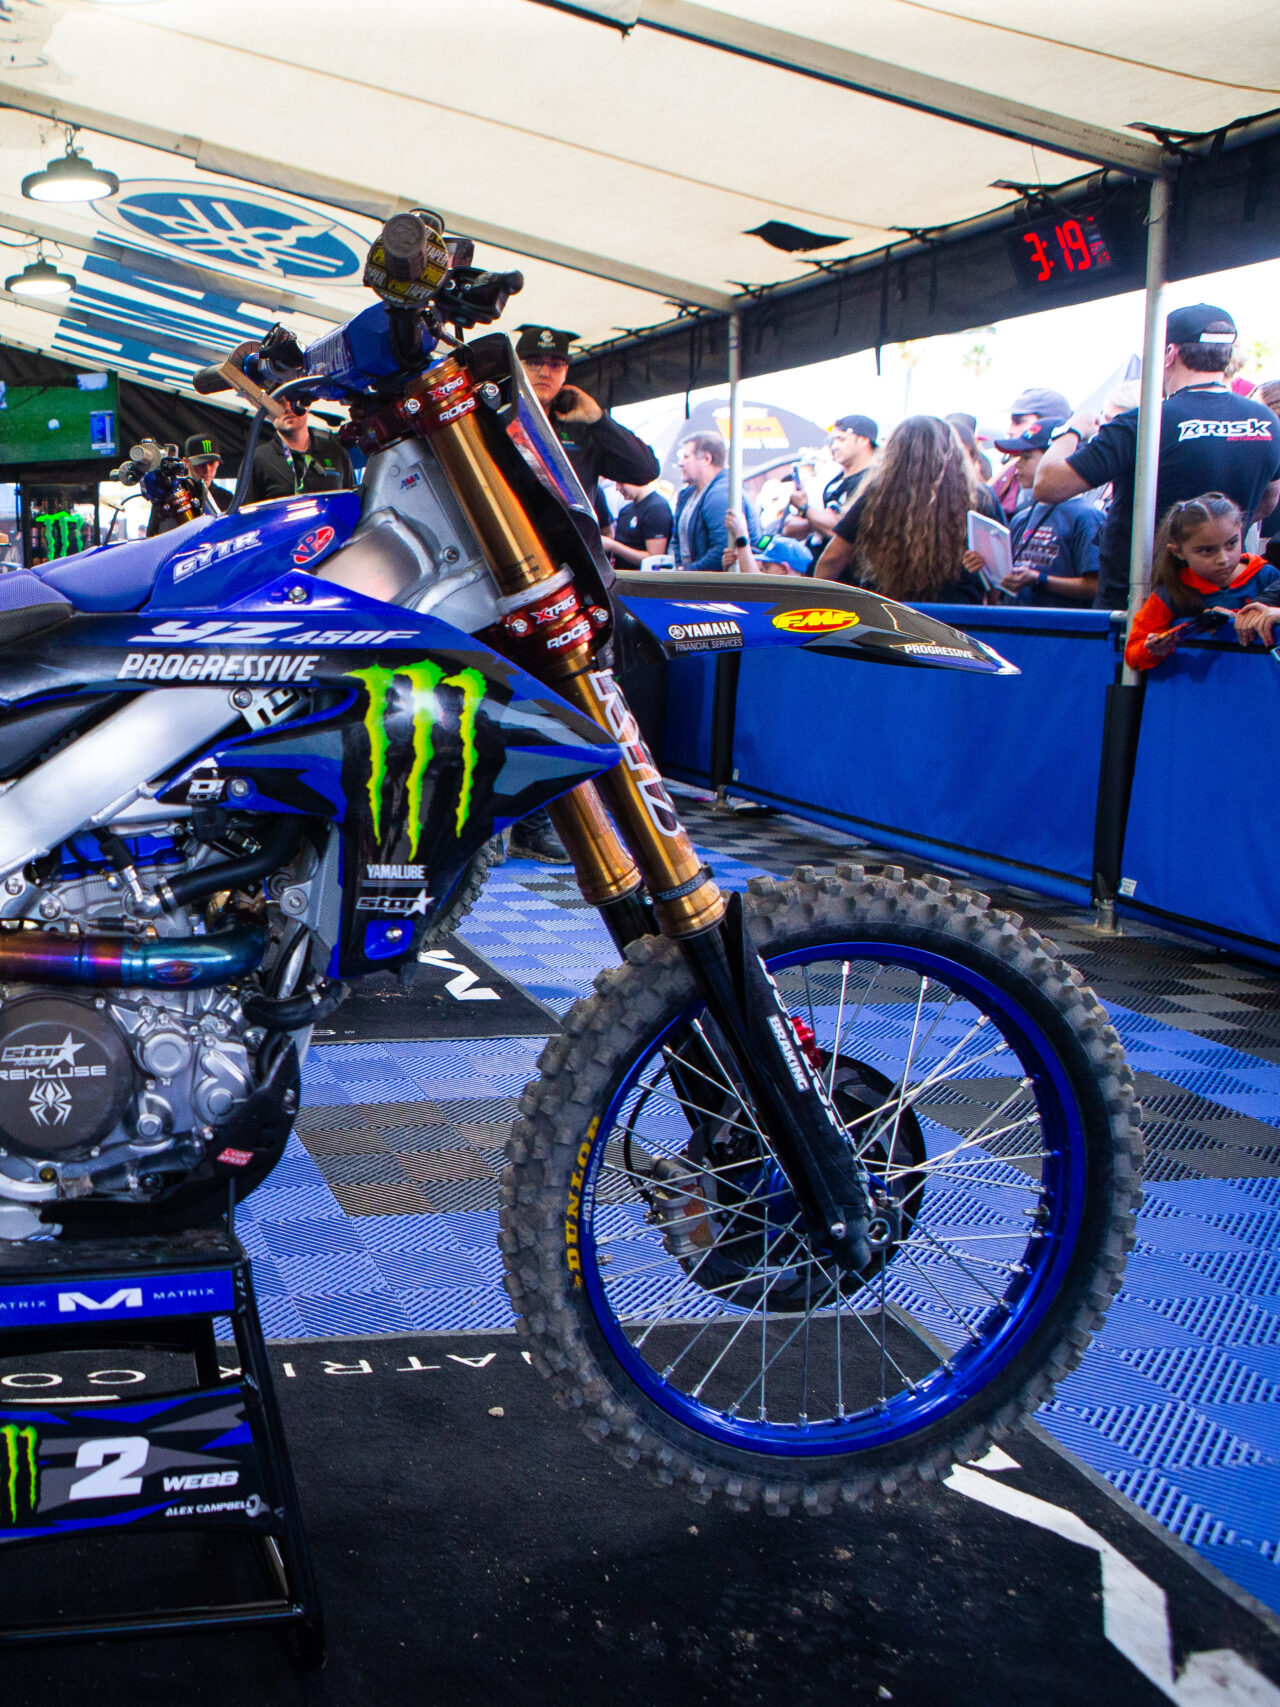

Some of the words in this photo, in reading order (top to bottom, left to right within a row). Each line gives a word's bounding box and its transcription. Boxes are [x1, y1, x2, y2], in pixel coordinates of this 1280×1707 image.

[1023, 219, 1092, 282] 3:19
[428, 376, 465, 401] XTRIG
[439, 397, 476, 422] ROCS
[173, 530, 260, 580] GYTR
[531, 594, 577, 625] XTRIG
[774, 611, 858, 630] FMF
[546, 619, 592, 650] ROCS
[684, 620, 741, 638] YAMAHA
[903, 643, 977, 661] PROGRESSIVE
[117, 652, 321, 682] PROGRESSIVE
[366, 864, 426, 879] YAMALUBE
[768, 1015, 810, 1092] BRAKING
[565, 1115, 601, 1272] DUNLOP
[153, 1287, 216, 1300] MATRIX
[69, 1435, 151, 1501] 2
[162, 1470, 240, 1493] WEBB
[164, 1503, 194, 1517] ALEX
[195, 1499, 254, 1515] CAMPBELL
